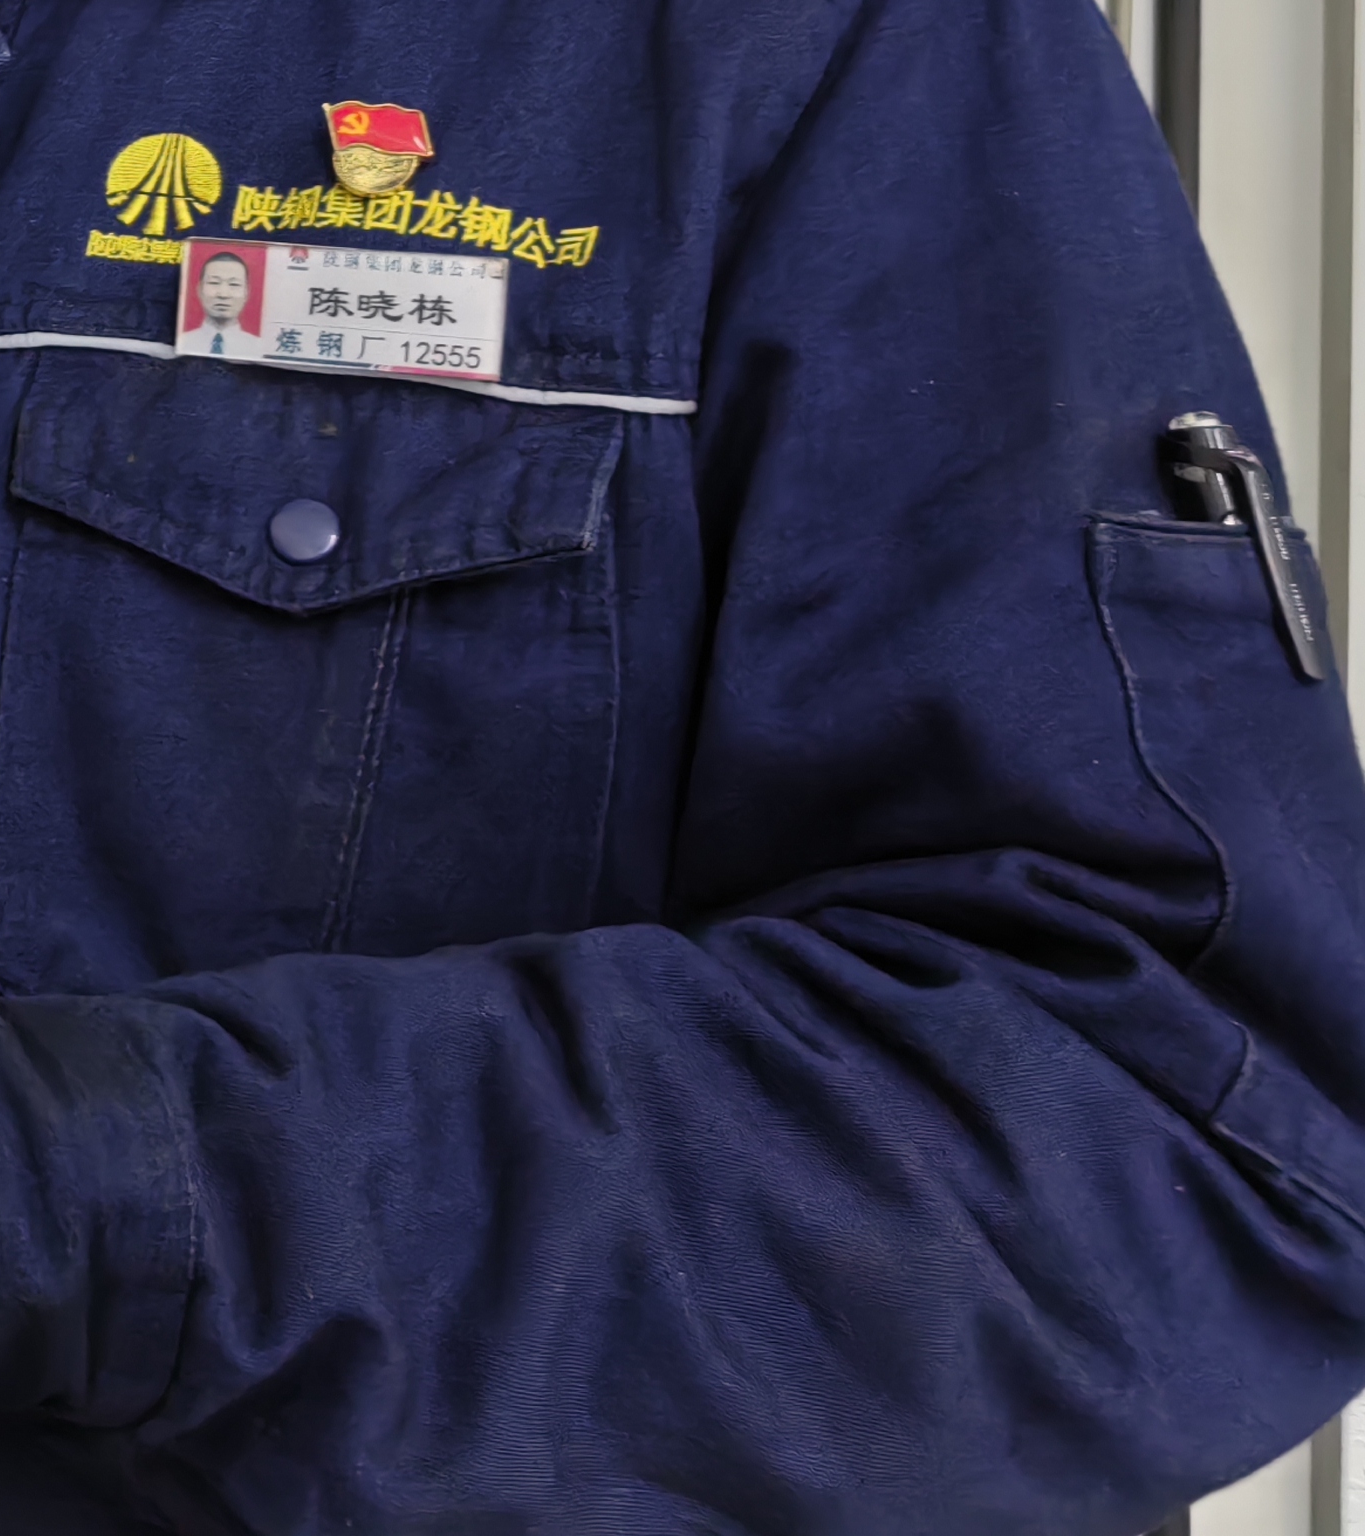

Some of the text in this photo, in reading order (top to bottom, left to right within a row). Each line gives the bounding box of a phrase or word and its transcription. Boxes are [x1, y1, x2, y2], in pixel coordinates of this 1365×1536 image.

[231, 184, 600, 269] 陕钢集团龙钢公司
[308, 287, 458, 326] 陈晓栋
[274, 327, 482, 369] 炼钢厂 12555
